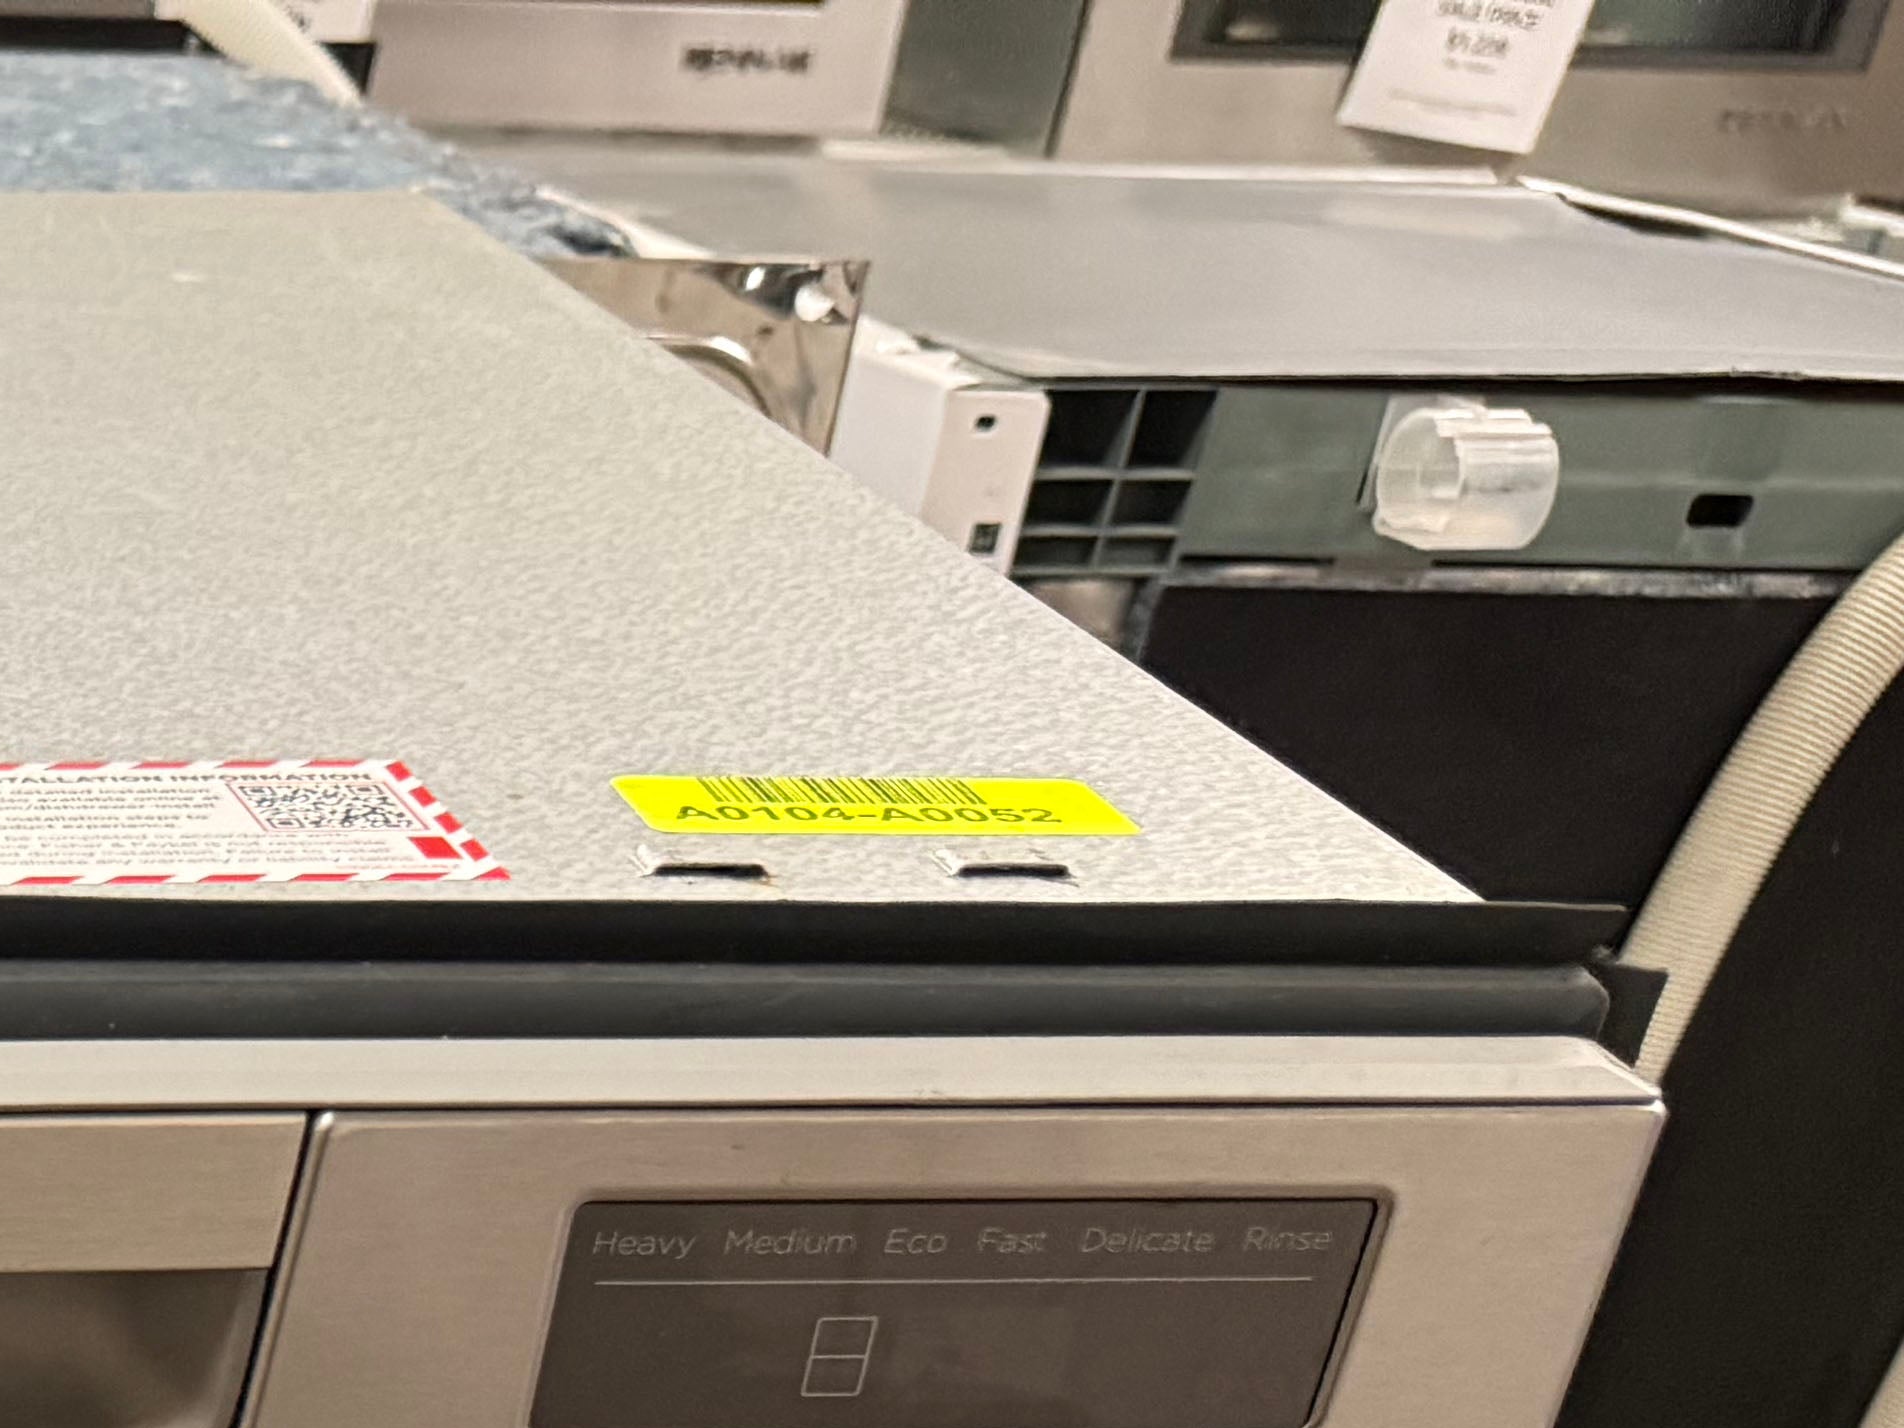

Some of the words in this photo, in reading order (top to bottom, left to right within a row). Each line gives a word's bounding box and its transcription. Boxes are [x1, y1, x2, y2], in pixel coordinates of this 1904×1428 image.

[169, 773, 373, 782] INFORMATION
[675, 805, 1063, 823] A0104-A0052
[593, 1230, 696, 1260] Heavy
[723, 1229, 856, 1255] Medium
[883, 1228, 948, 1254] Eco
[978, 1227, 1047, 1253] Fast
[1080, 1226, 1215, 1253] Delicate
[1242, 1226, 1334, 1252] Rinse
